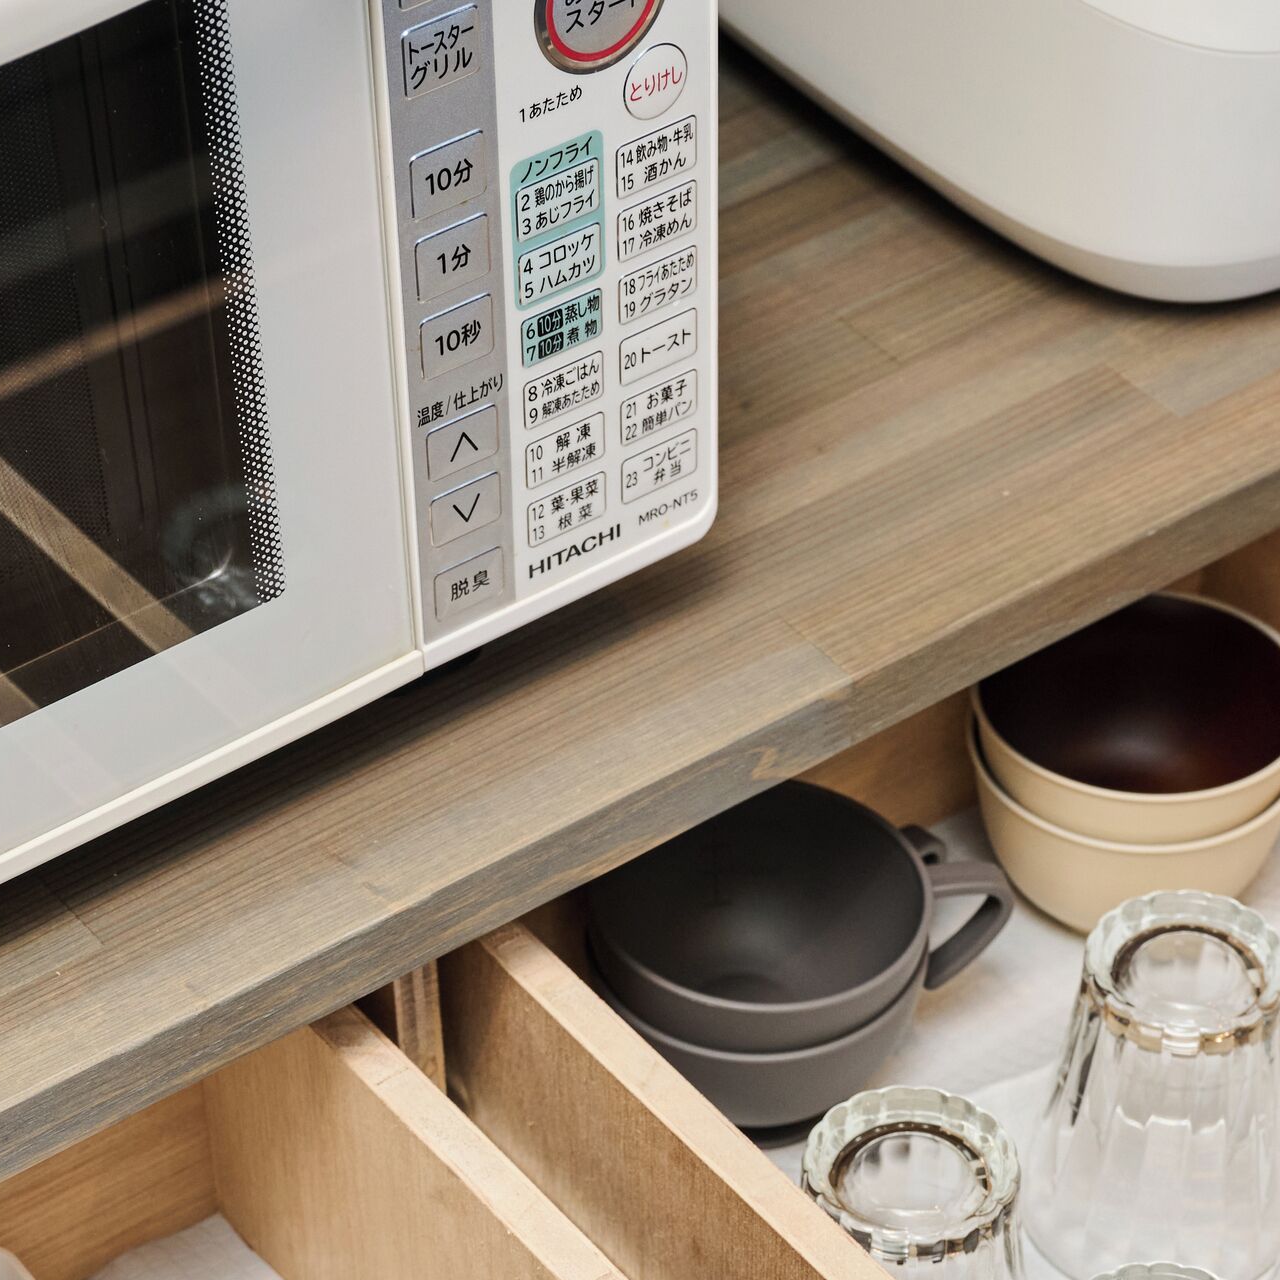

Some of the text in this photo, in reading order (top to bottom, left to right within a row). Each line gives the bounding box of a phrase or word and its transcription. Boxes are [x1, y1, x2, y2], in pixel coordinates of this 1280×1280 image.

[408, 24, 474, 65] トースター
[410, 47, 473, 89] グリル
[630, 66, 683, 101] とりけし
[528, 85, 583, 119] あたため
[520, 136, 593, 183] ノンフライ
[620, 123, 694, 168] 14 飲み物・牛乳
[425, 158, 474, 195] 10分
[521, 165, 594, 212] 2 鶏のから揚げ
[621, 152, 686, 192] 15 酒かん
[522, 189, 595, 235] 3 あじフライ
[622, 187, 692, 232] 16 焼きそば
[523, 233, 594, 274] 4 コロッケ
[622, 213, 692, 255] 17 冷凍めん
[436, 243, 471, 274] 1分
[524, 254, 595, 299] 5 ハムカツ
[623, 251, 695, 296] 18 フライあたため
[526, 294, 600, 340] 6 10分 蒸し物
[624, 277, 692, 318] 19 グラタン
[434, 320, 482, 356] 10秒
[526, 345, 537, 361] 7
[539, 333, 564, 357] 10分
[624, 328, 691, 370] 20 トースト
[417, 373, 503, 428] 温度/仕上がり
[528, 359, 600, 402] 8 冷凍ごはん
[626, 379, 687, 419] 21 お菓子
[529, 380, 600, 424] 9 解凍あたため
[625, 399, 692, 441] 22 簡単パン
[530, 445, 543, 462] 10
[532, 442, 596, 483] 11 半解凍
[626, 439, 691, 489] 23 コンビニ
[532, 504, 544, 521] 12
[638, 488, 698, 526] MRO-NT5
[528, 523, 622, 579] HITACHI
[533, 525, 545, 541] 13
